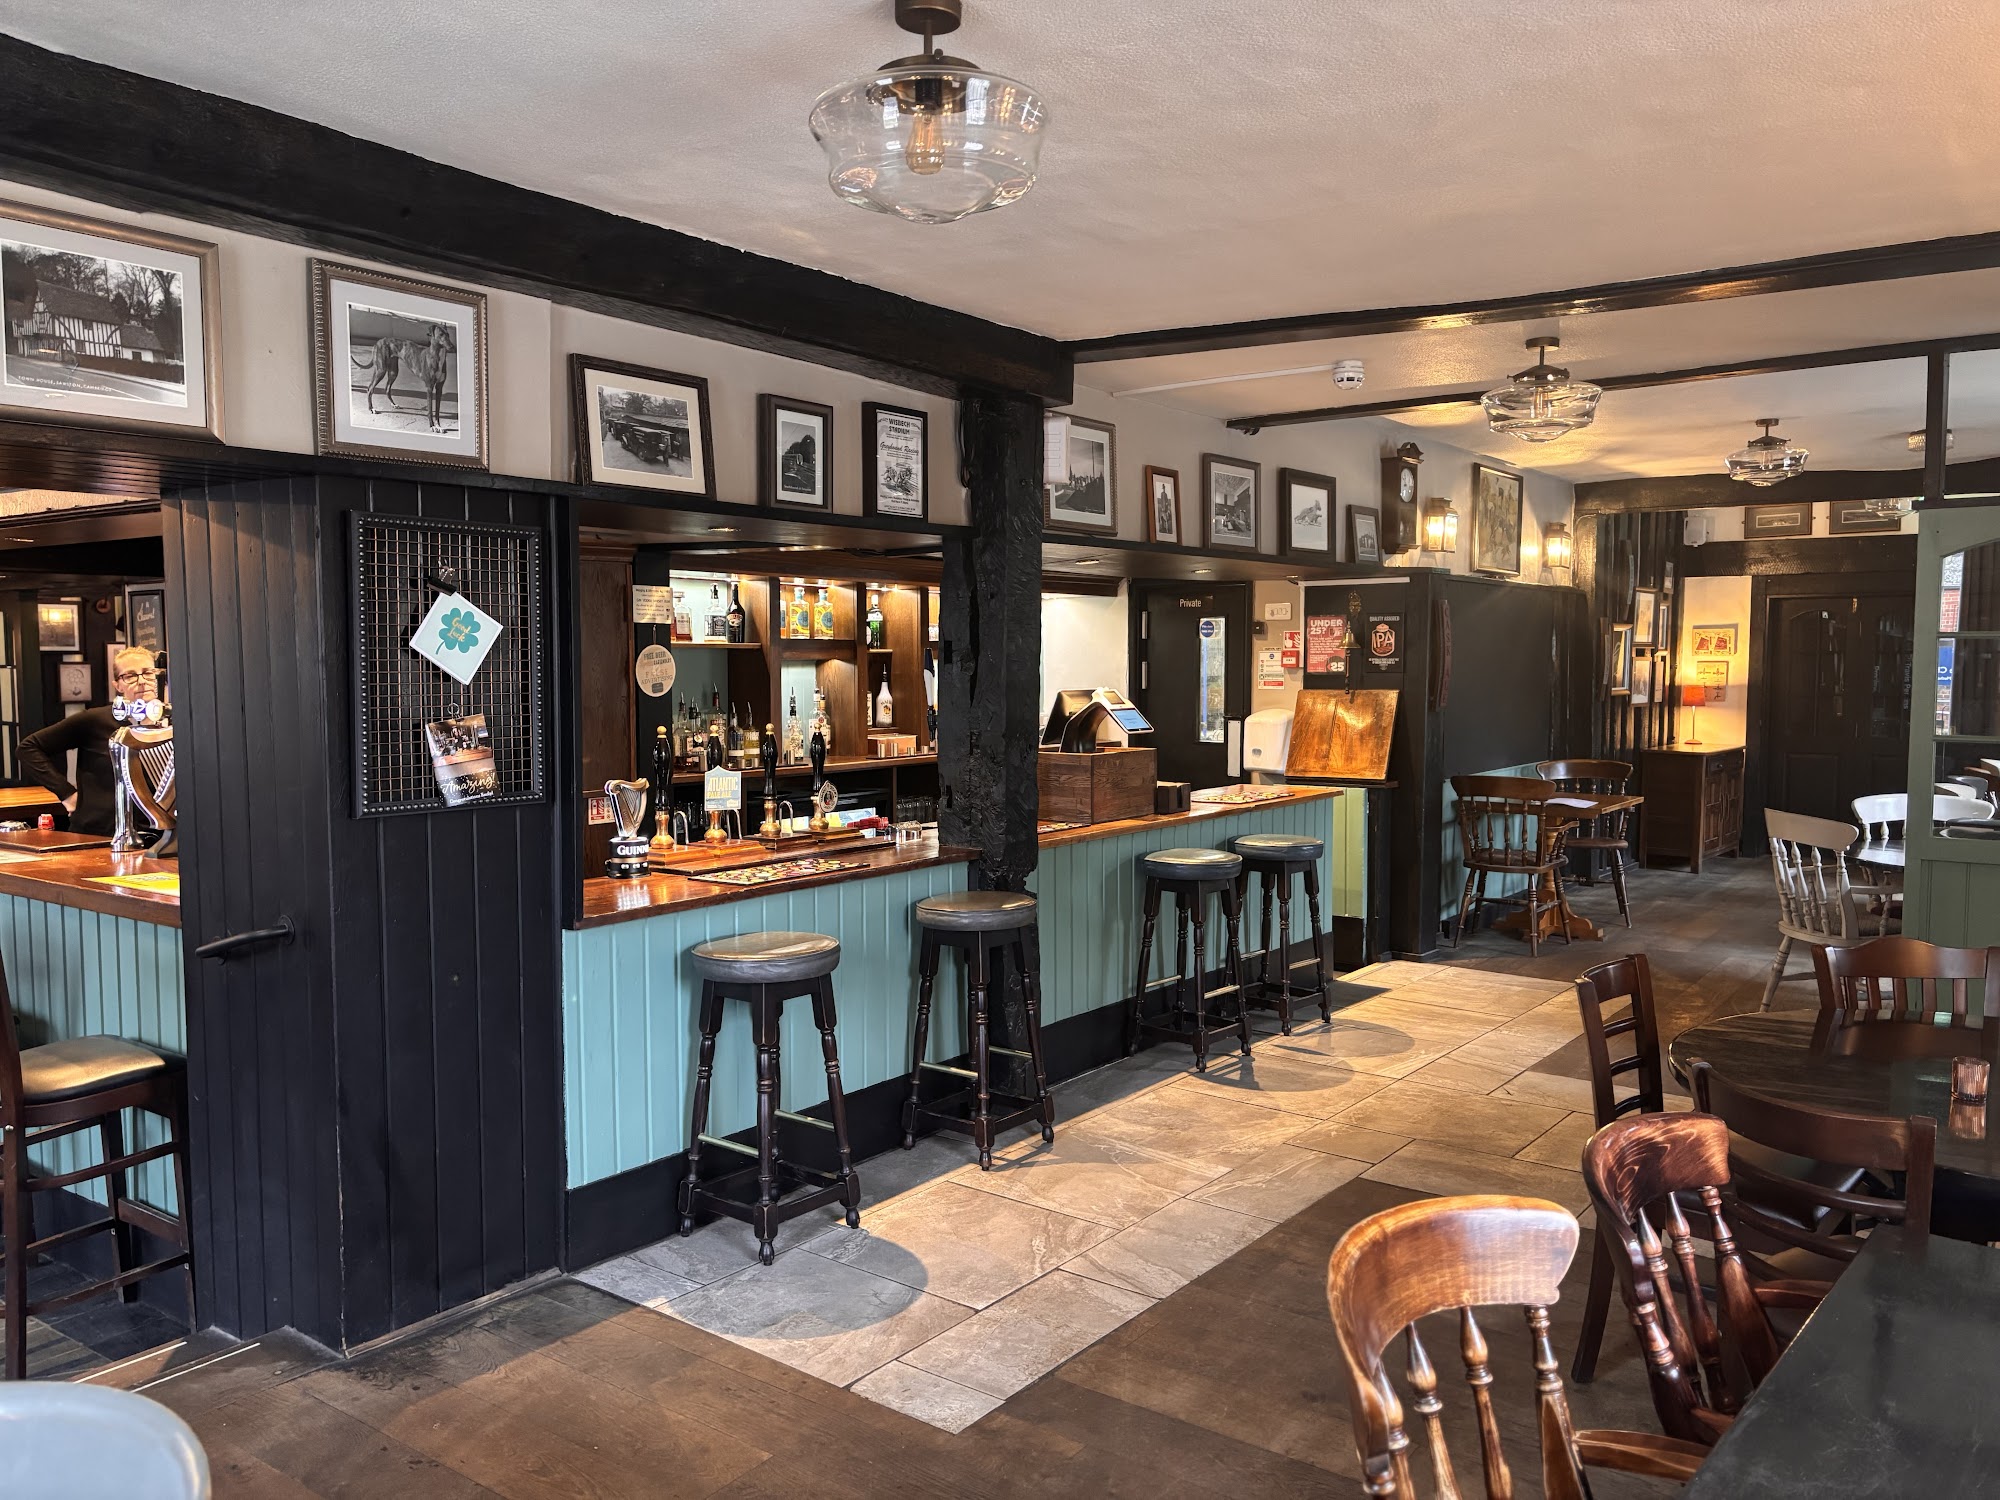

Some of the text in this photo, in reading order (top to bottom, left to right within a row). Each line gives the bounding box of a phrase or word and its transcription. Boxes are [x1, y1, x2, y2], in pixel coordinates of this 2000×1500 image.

[889, 418, 911, 428] WISBECH
[889, 426, 910, 435] STADIUM
[1179, 598, 1202, 608] Private
[452, 617, 472, 634] Good
[1310, 619, 1343, 627] UNDER
[447, 627, 465, 642] Luck
[1310, 627, 1327, 635] 25?
[1372, 630, 1394, 649] IPA
[1330, 661, 1345, 672] 25
[440, 772, 495, 794] Amazing!
[708, 776, 738, 791] ATLANTIC
[707, 790, 732, 799] PALE ALE
[617, 844, 650, 855] GUINN
